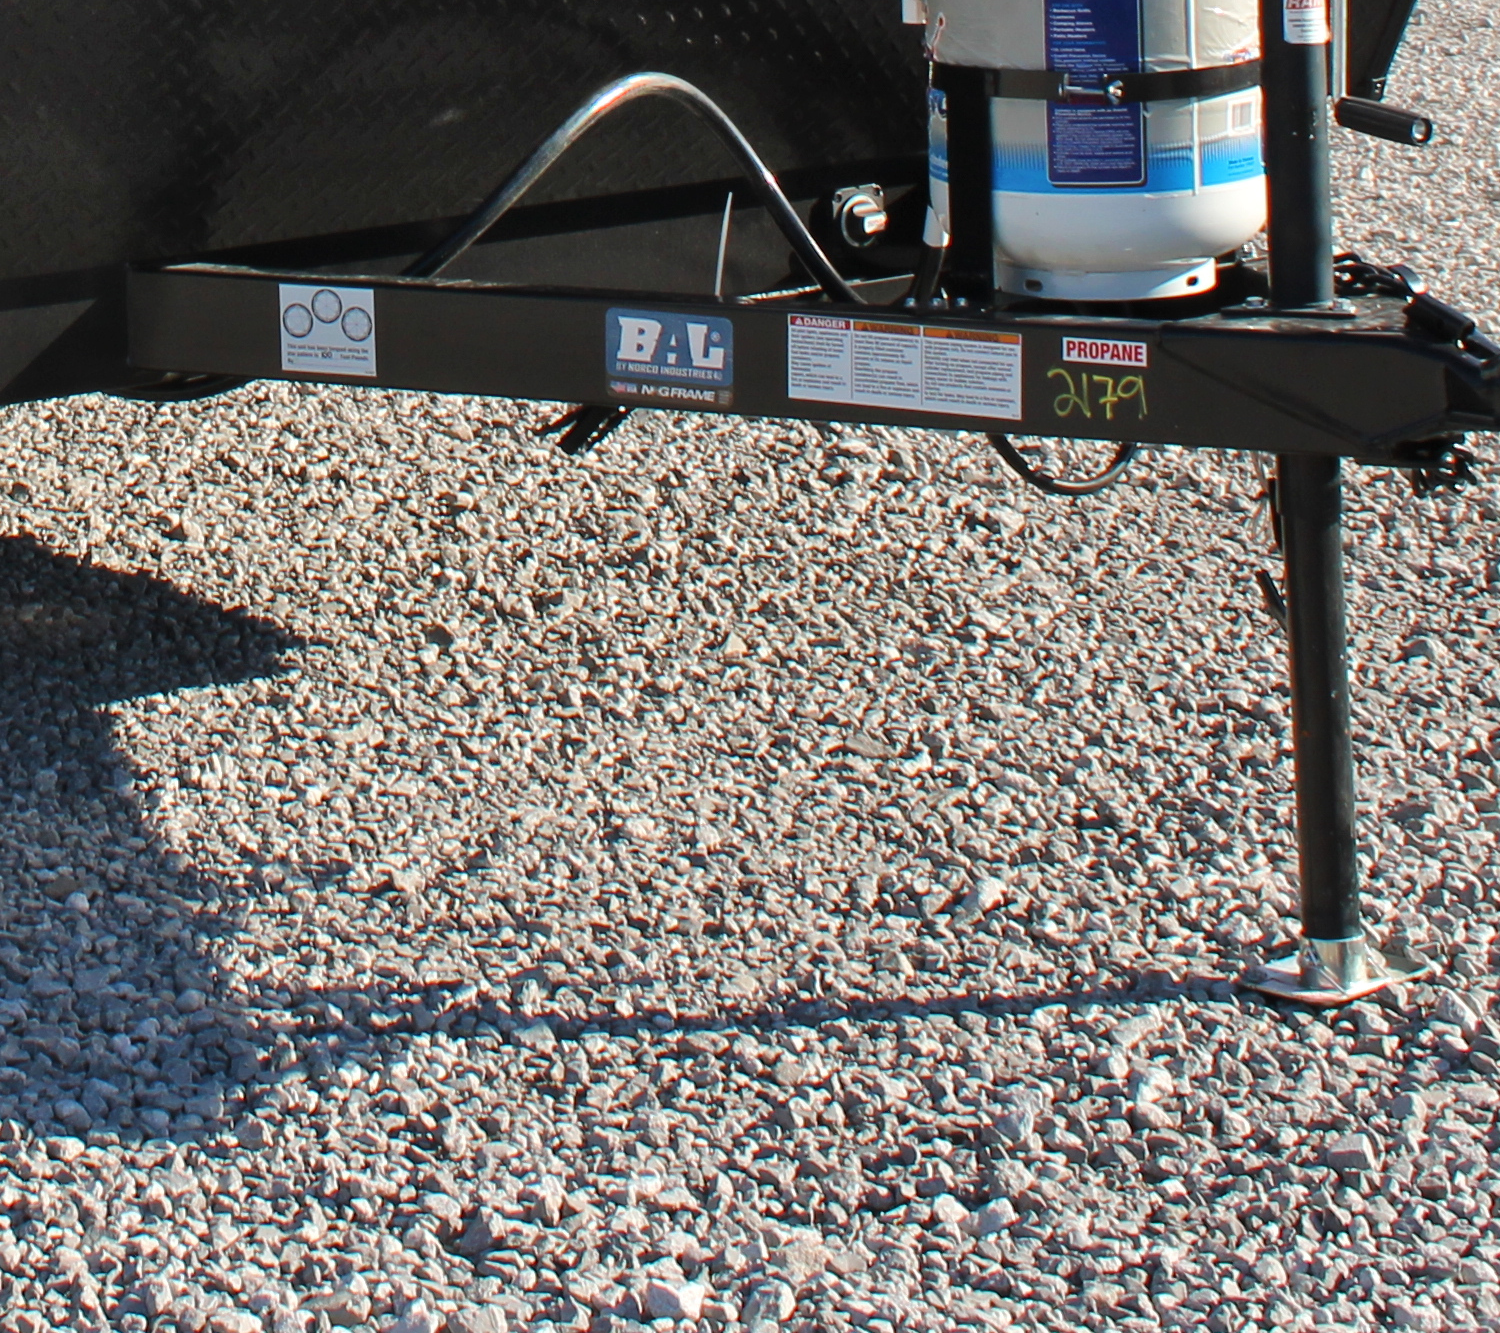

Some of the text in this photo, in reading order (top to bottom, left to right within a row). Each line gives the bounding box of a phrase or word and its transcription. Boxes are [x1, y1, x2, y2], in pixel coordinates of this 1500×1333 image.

[804, 318, 846, 330] DANGER
[1066, 340, 1144, 364] PROPANE
[616, 361, 713, 380] BY NORCO INDUSTRIES
[1047, 367, 1147, 420] 2179
